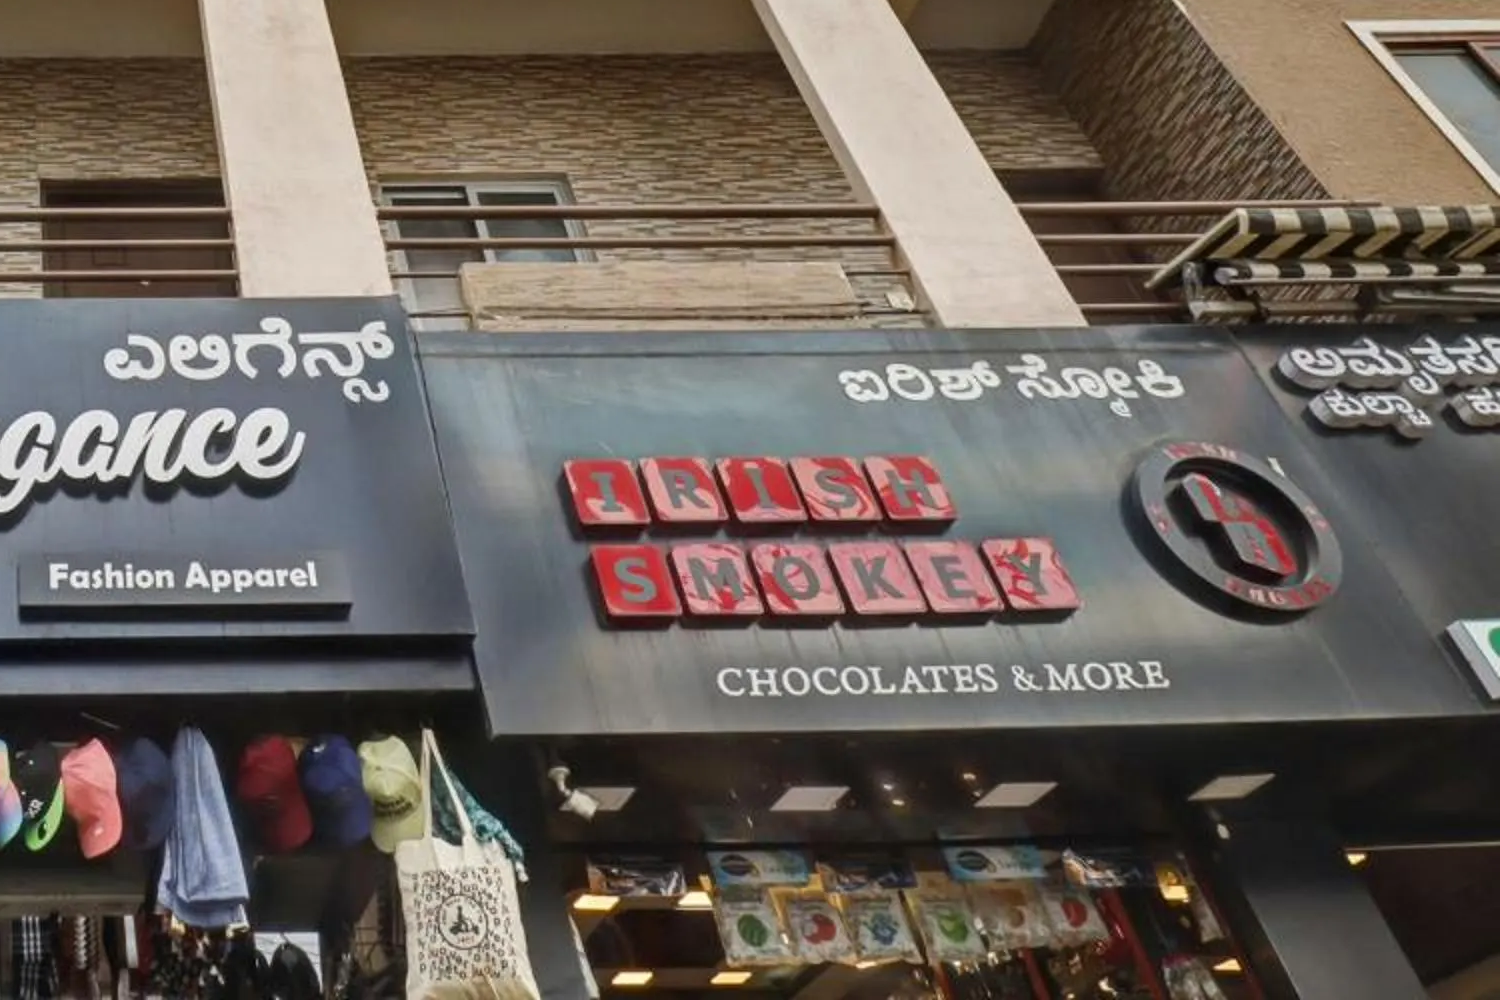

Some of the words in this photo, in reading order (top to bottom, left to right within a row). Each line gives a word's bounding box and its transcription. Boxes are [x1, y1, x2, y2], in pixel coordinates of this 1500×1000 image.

[838, 361, 1001, 402] ಐರಿಶ್
[588, 467, 941, 515] IRISH
[48, 562, 175, 590] Fashion
[185, 560, 319, 594] Apparel
[612, 551, 1052, 603] SMOKEY
[715, 663, 999, 697] CHOCOLATES
